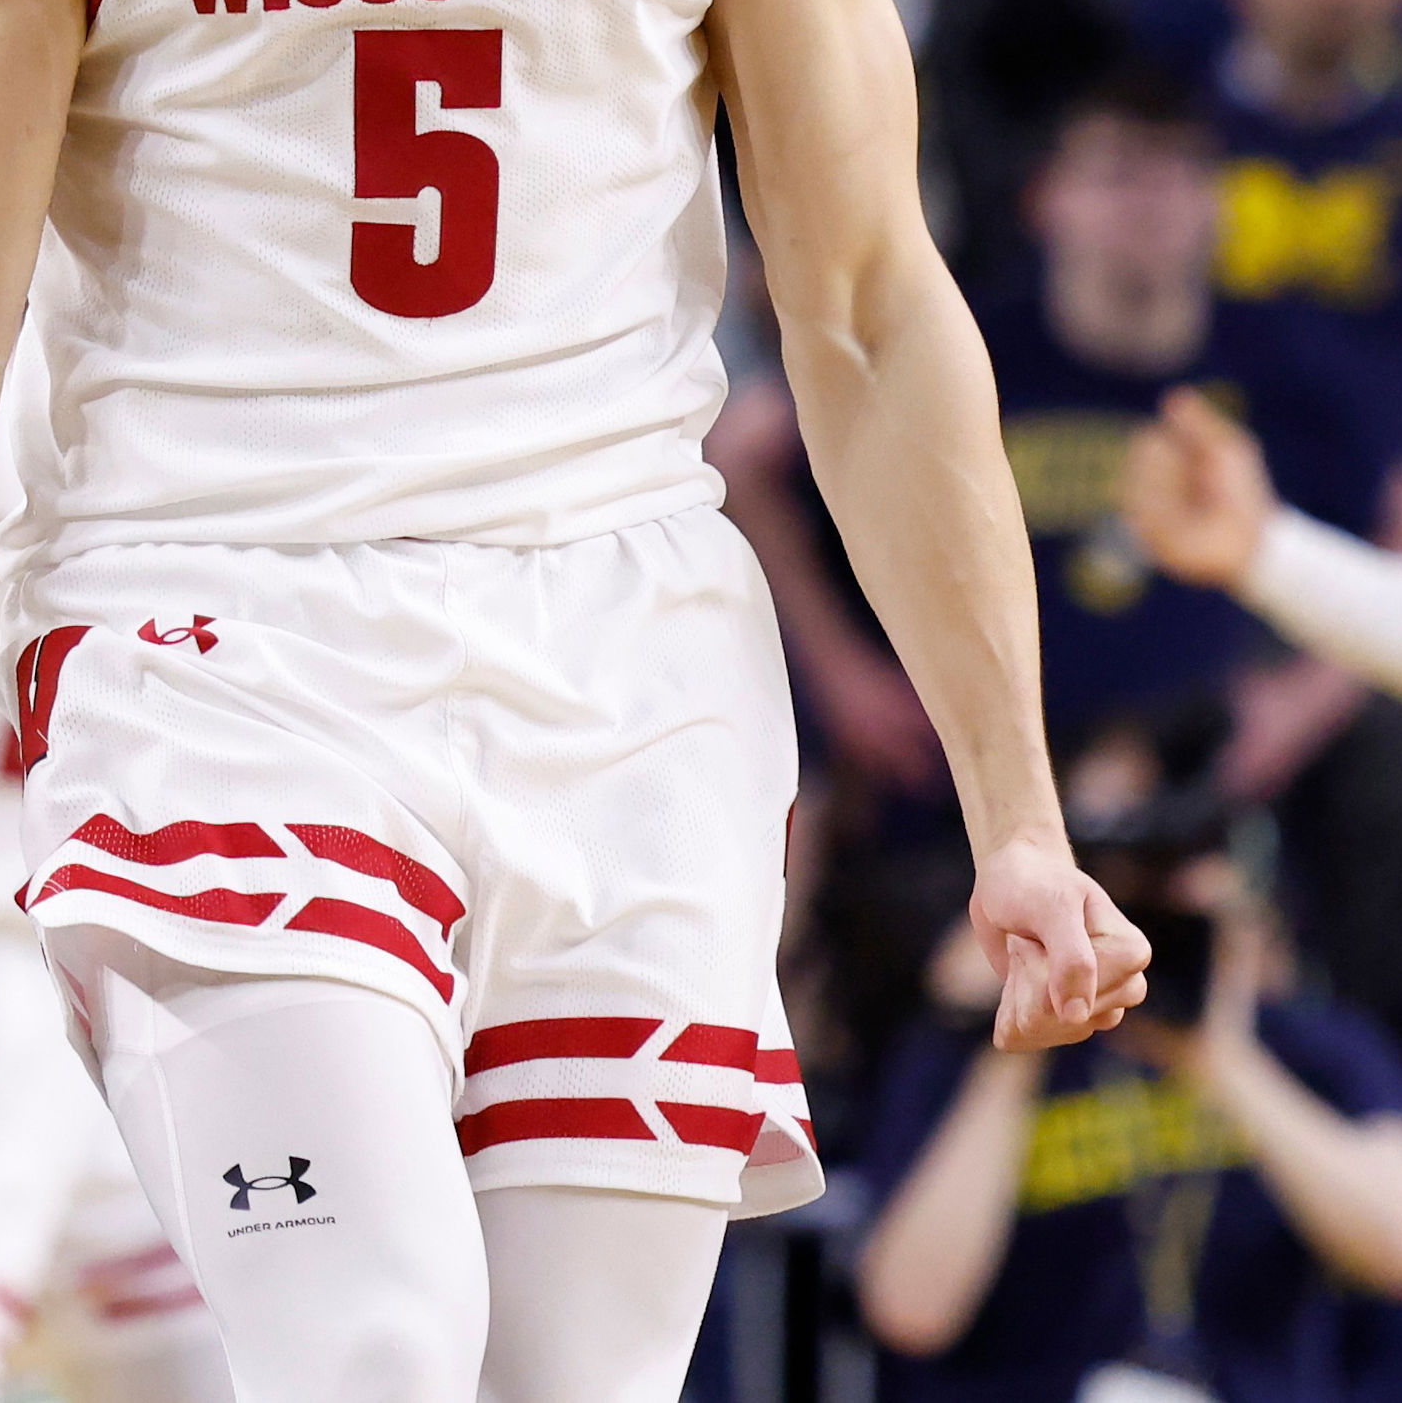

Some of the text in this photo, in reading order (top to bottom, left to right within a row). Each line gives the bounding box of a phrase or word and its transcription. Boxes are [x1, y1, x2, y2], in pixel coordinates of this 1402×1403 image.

[350, 29, 503, 318] 5
[227, 1216, 337, 1239] UNDER ARMOUR
